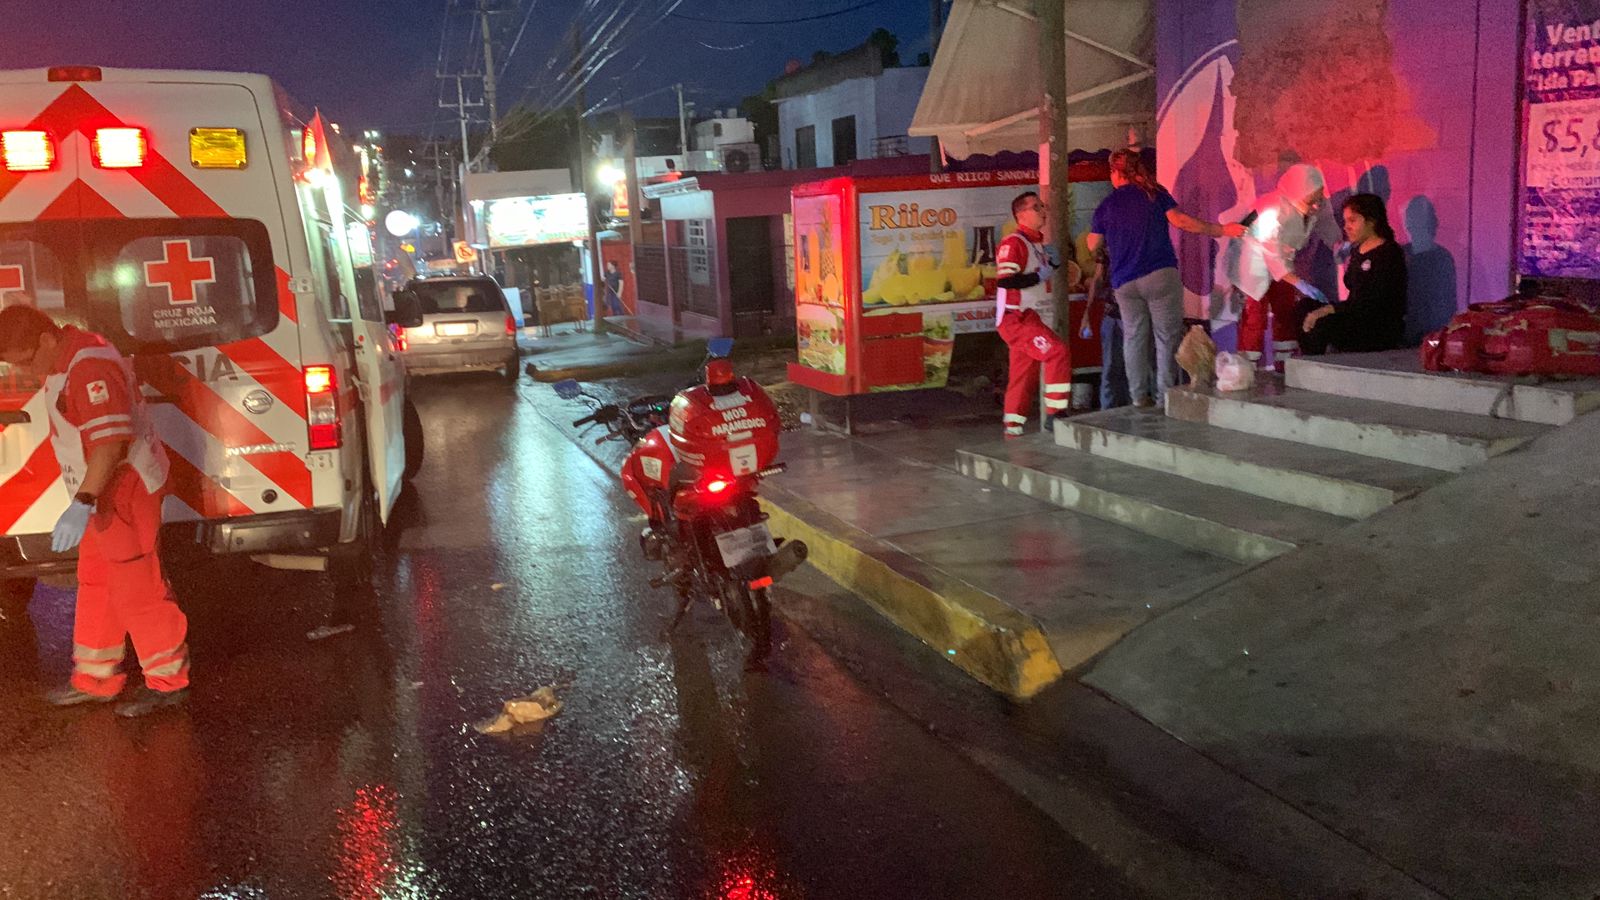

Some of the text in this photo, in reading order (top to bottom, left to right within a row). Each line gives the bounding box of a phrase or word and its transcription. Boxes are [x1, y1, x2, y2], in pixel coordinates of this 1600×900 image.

[930, 173, 951, 183] QUE
[956, 171, 991, 182] RIICO
[869, 202, 957, 230] Riico
[153, 305, 216, 318] CRUZ ROJA
[154, 316, 217, 329] MEXICANA
[711, 417, 767, 436] PARAMEDICO
